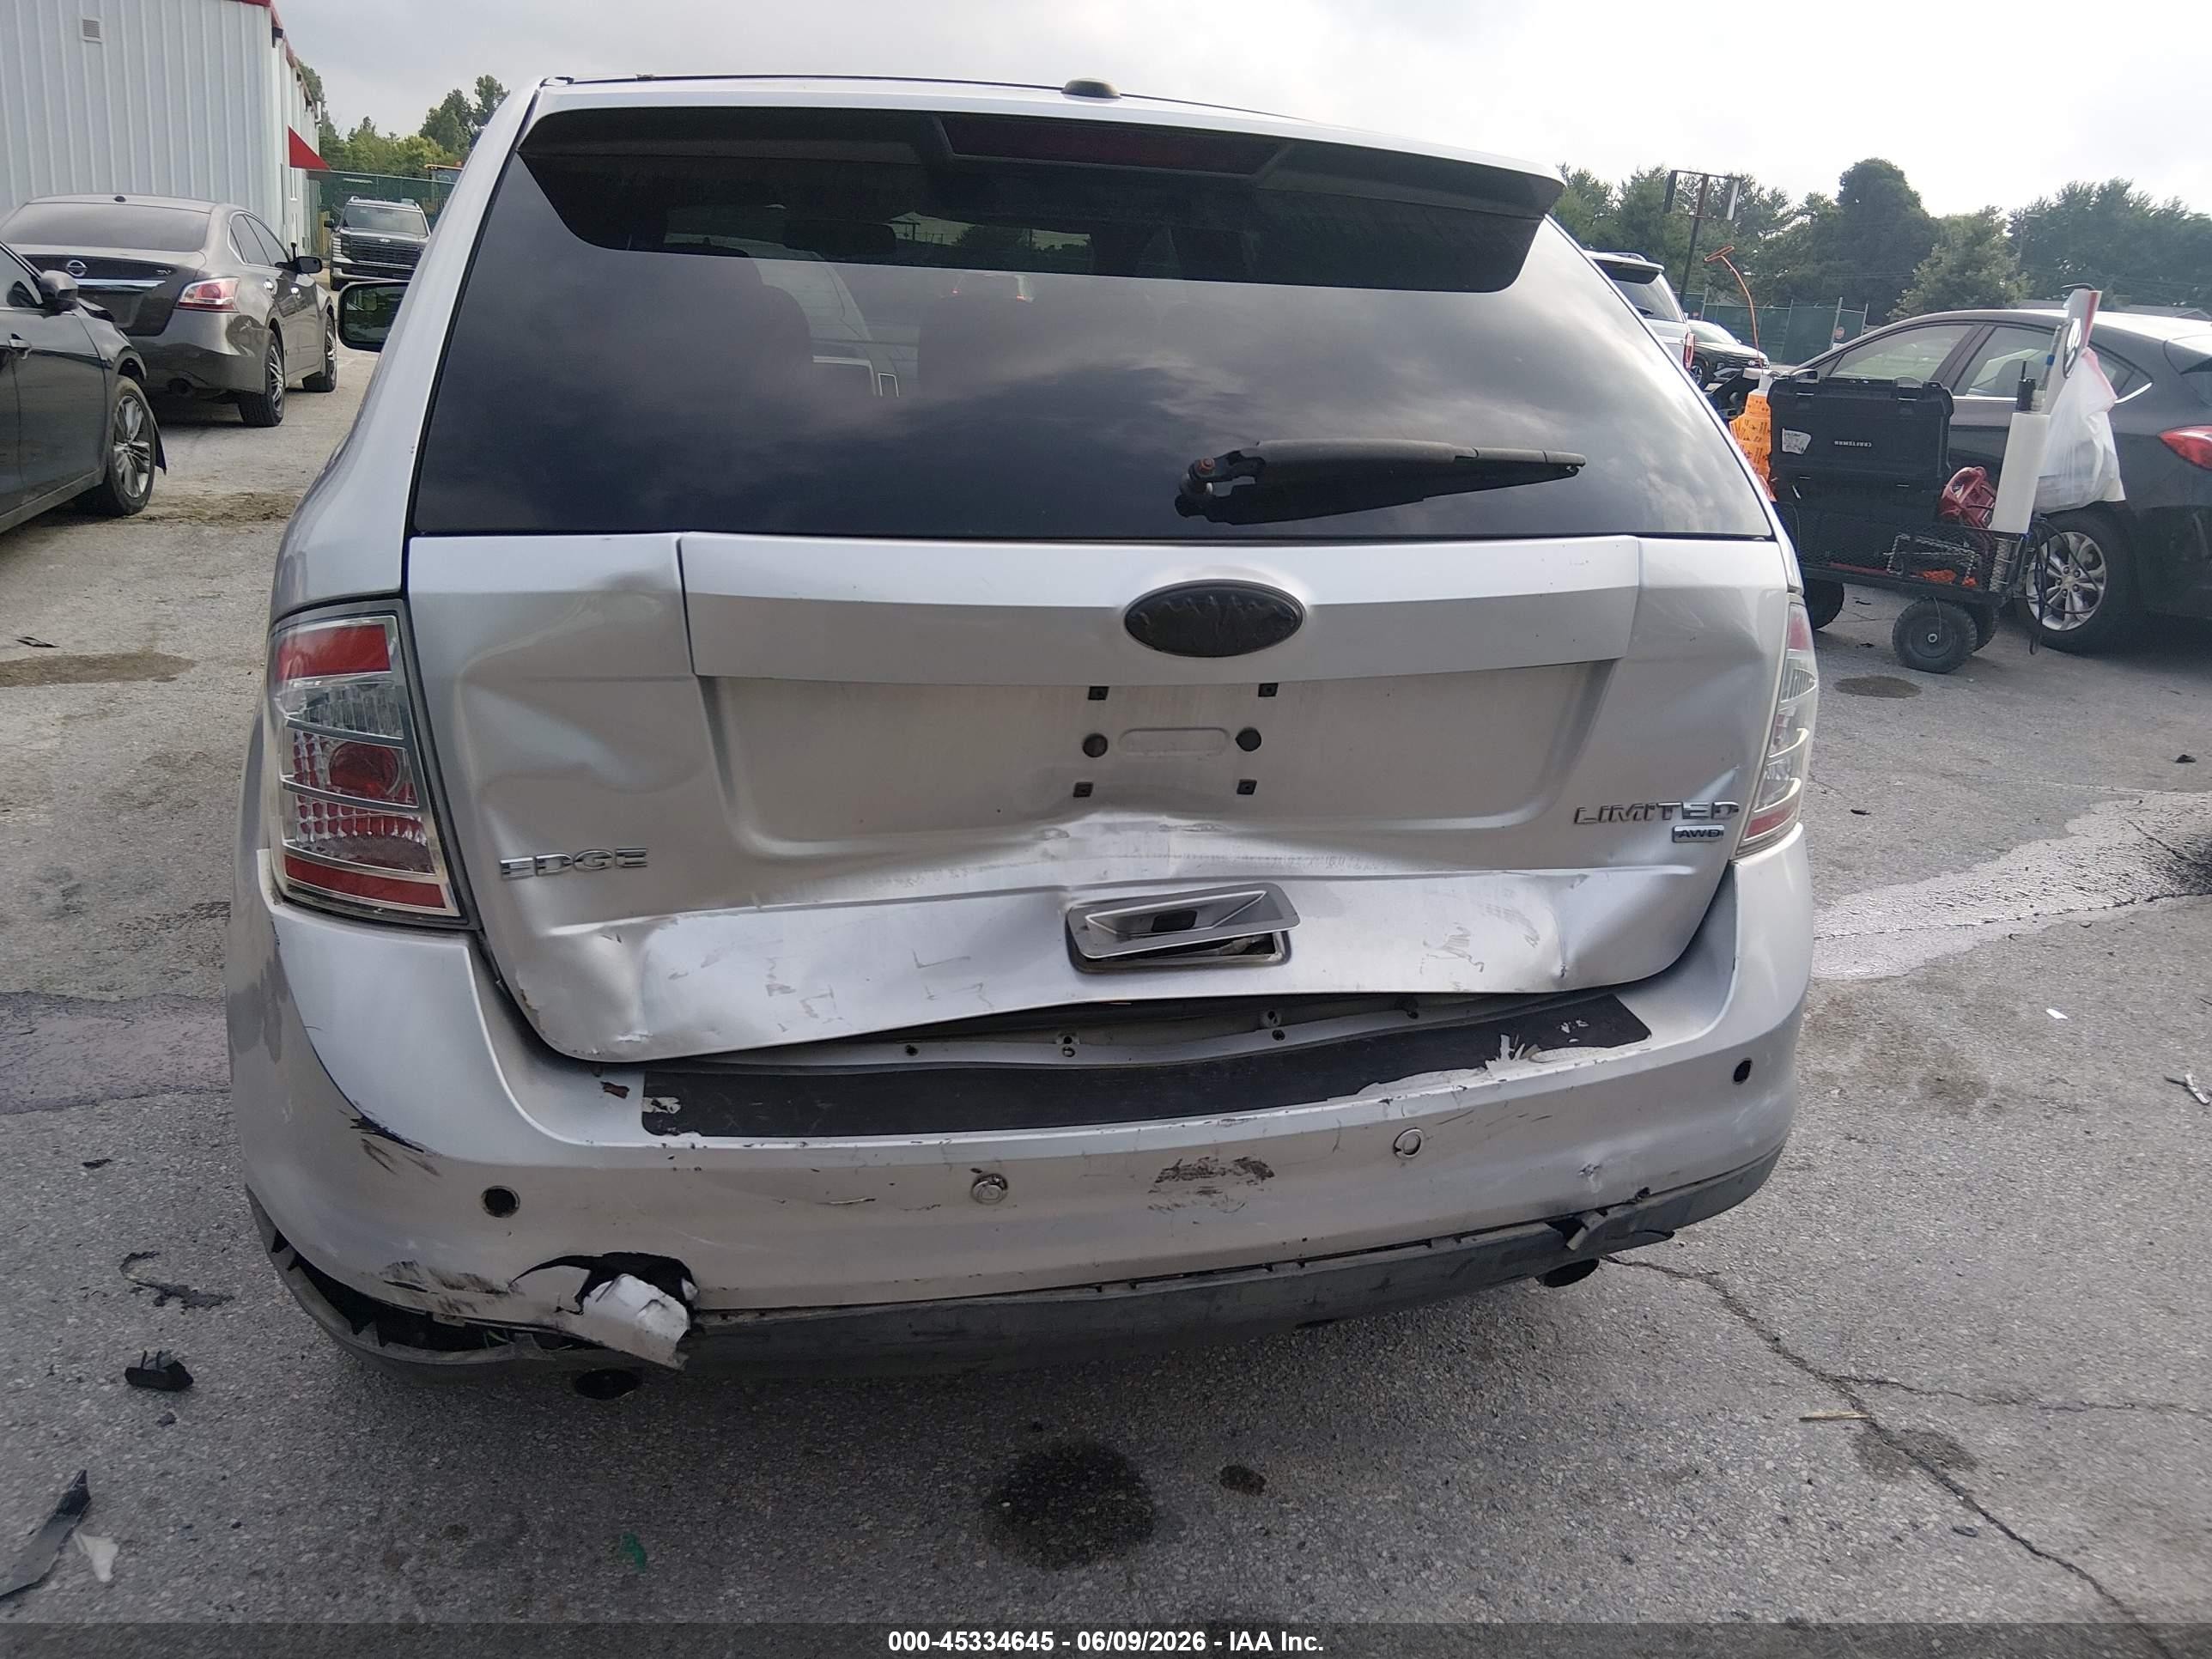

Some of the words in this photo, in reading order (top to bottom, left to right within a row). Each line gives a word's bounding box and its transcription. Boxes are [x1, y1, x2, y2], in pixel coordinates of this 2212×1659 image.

[1574, 800, 1740, 825] LIMITED
[1677, 829, 1722, 839] AWD
[499, 848, 648, 881] EDGE
